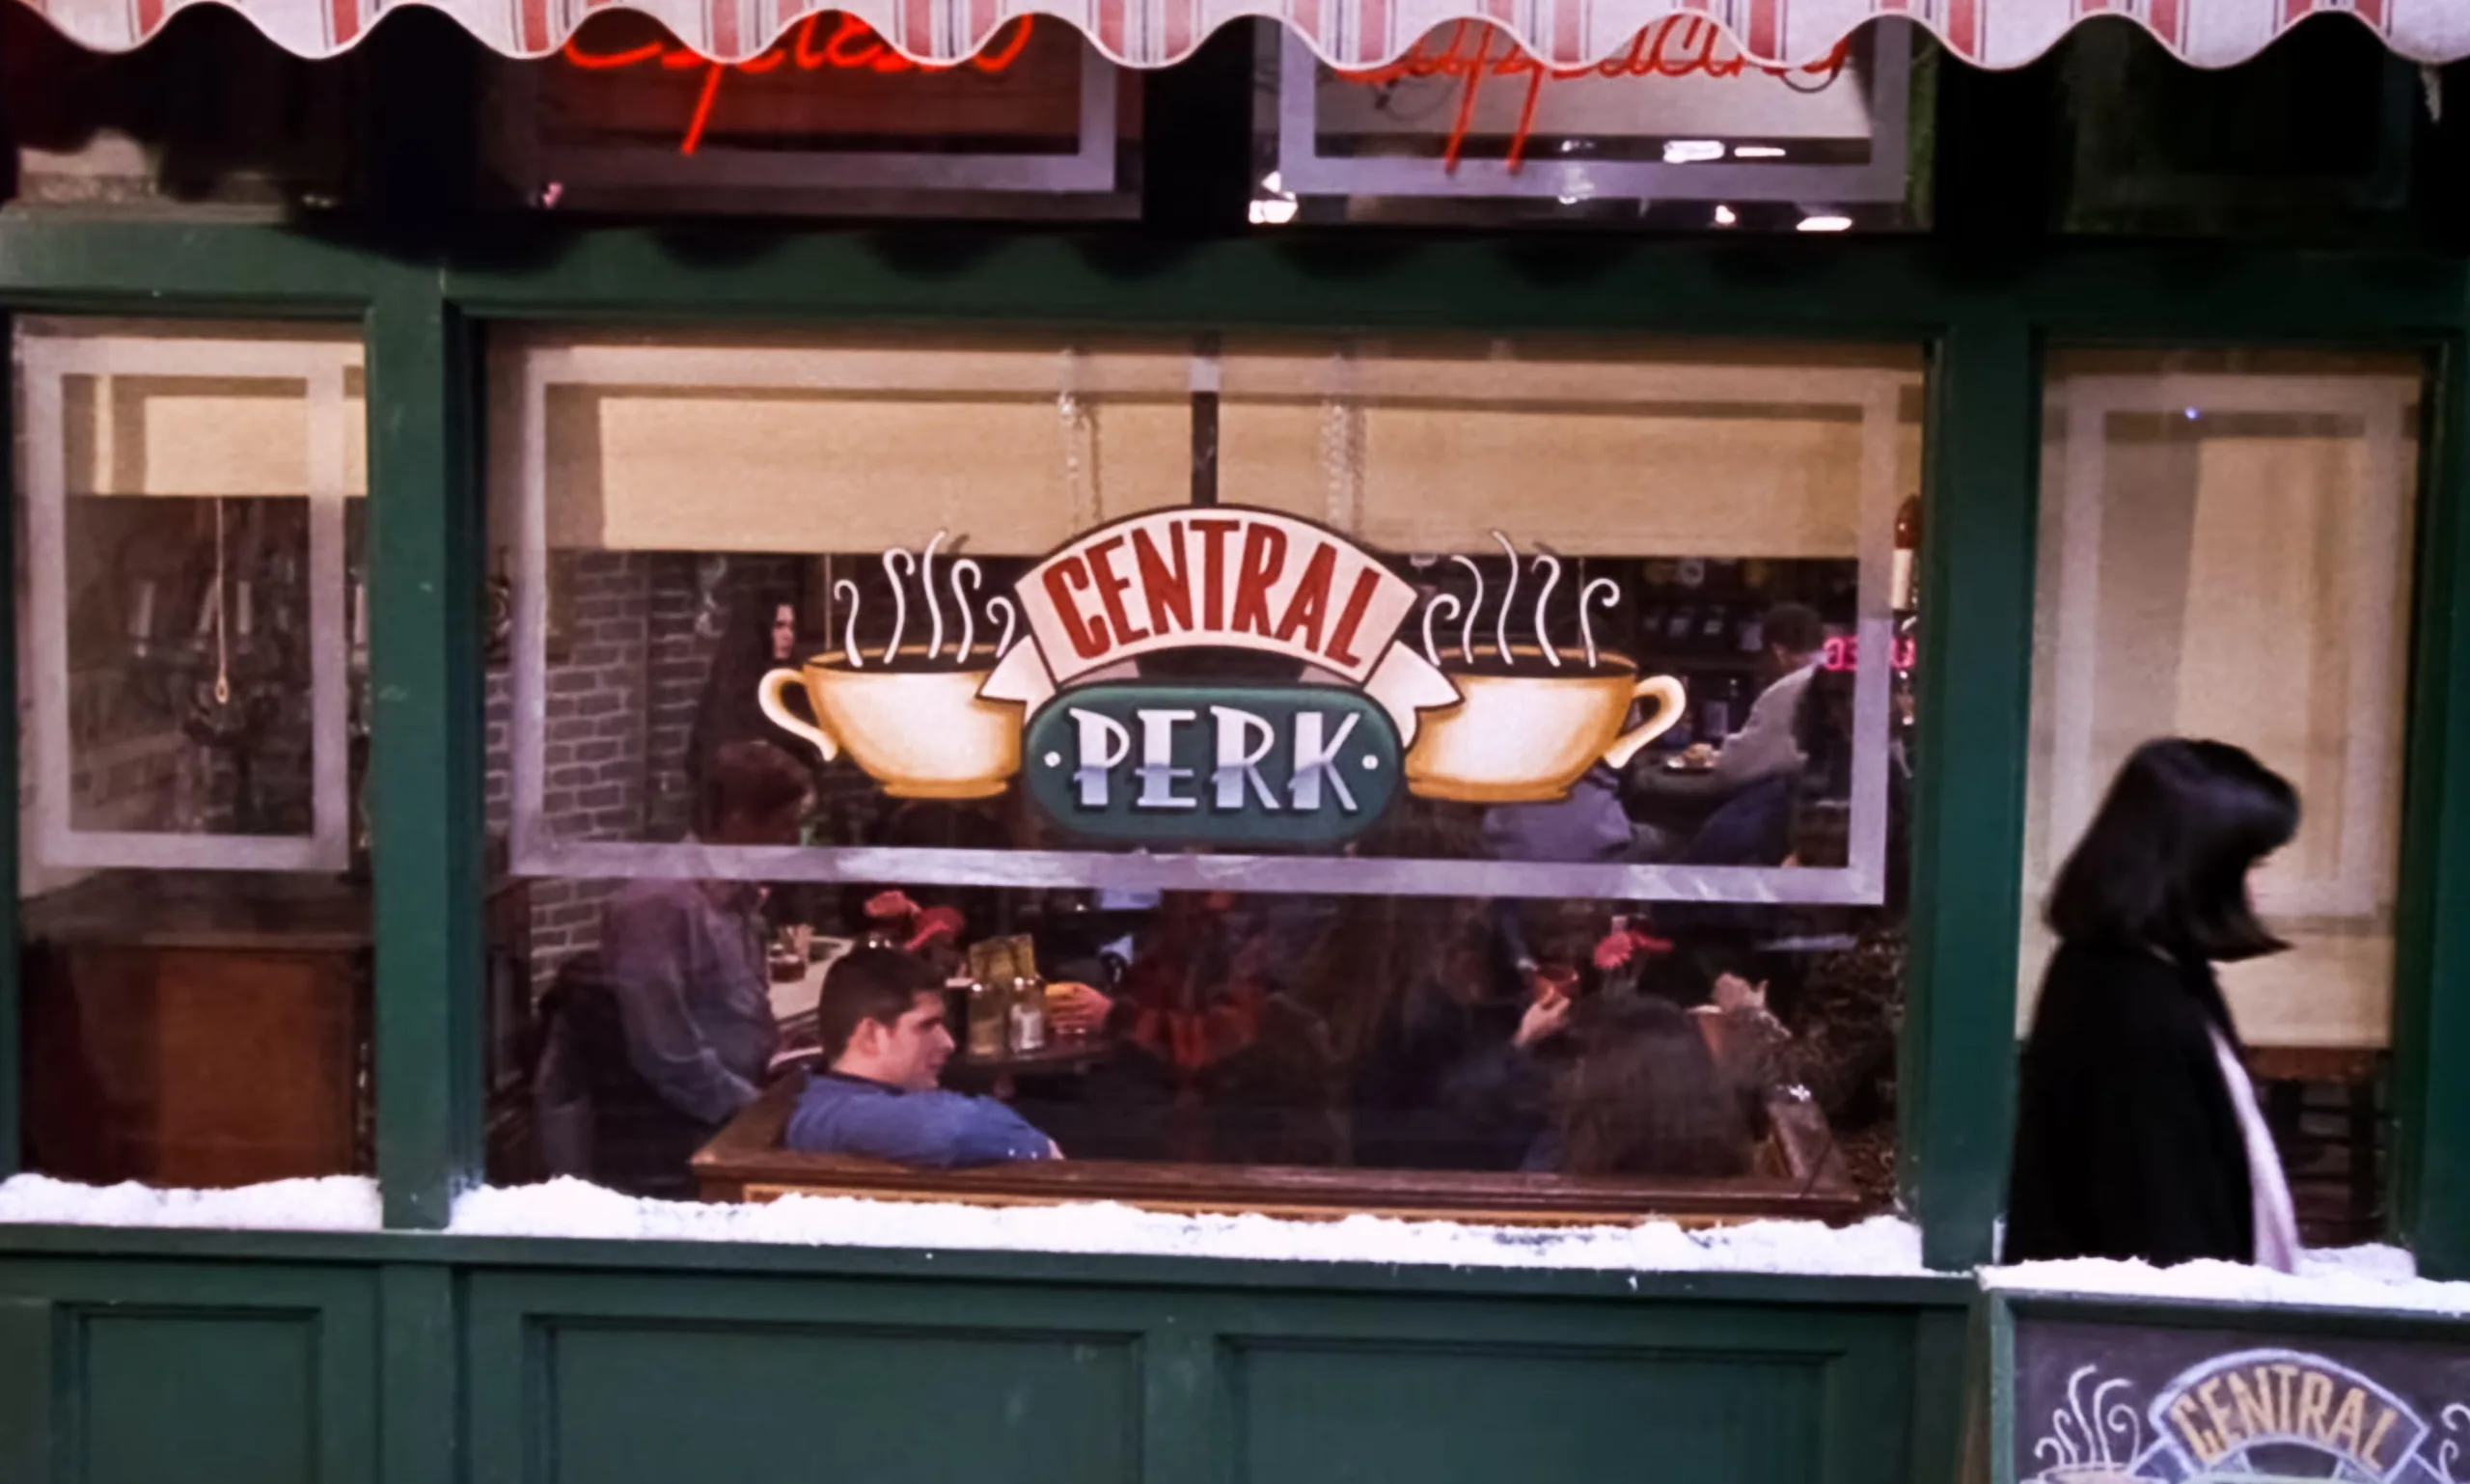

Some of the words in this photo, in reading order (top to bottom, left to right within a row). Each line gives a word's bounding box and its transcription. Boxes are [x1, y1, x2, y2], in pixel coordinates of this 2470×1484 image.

[1042, 518, 1382, 669] CENTRAL
[1068, 704, 1361, 811] PERK
[2171, 1362, 2399, 1473] CENTRAL
